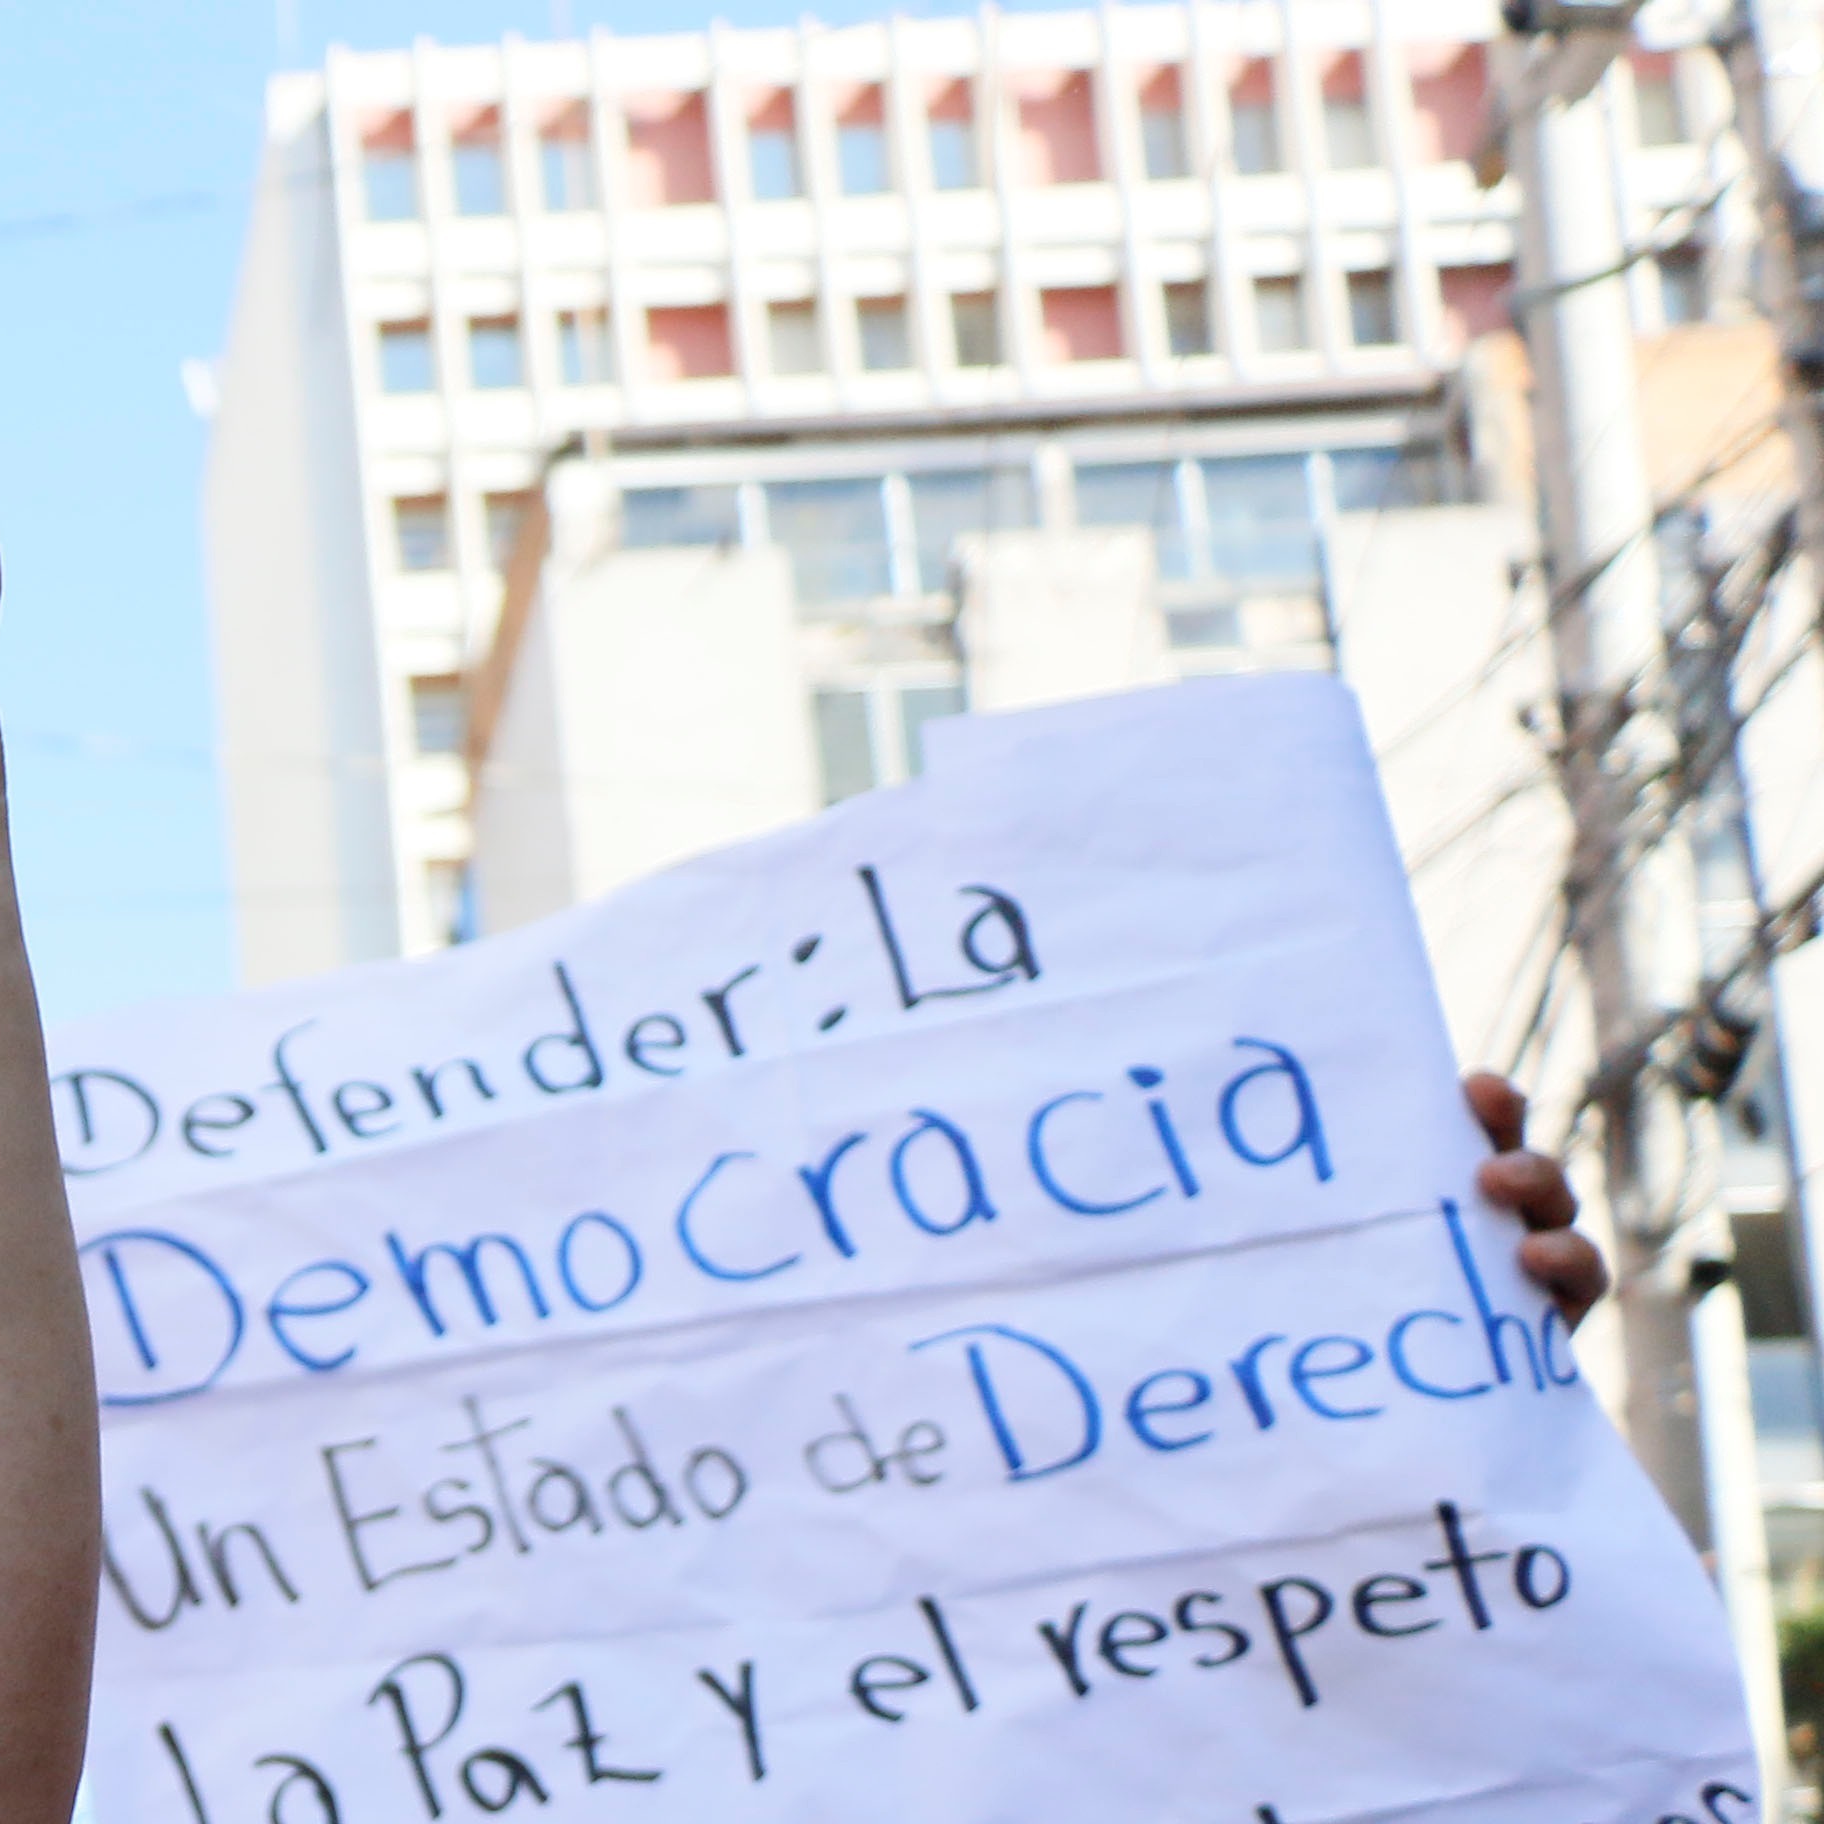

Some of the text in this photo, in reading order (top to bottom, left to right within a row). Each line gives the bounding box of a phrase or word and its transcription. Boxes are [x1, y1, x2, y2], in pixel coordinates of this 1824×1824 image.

[857, 865, 1040, 1010] La
[77, 1037, 1334, 1405] Democracia
[102, 1486, 299, 1631] Un
[322, 1396, 748, 1591] Estado
[805, 1394, 945, 1493] de
[368, 1652, 663, 1820] Paz
[697, 1661, 765, 1780] y
[849, 1596, 979, 1722] el
[1039, 1501, 1571, 1707] respeto
